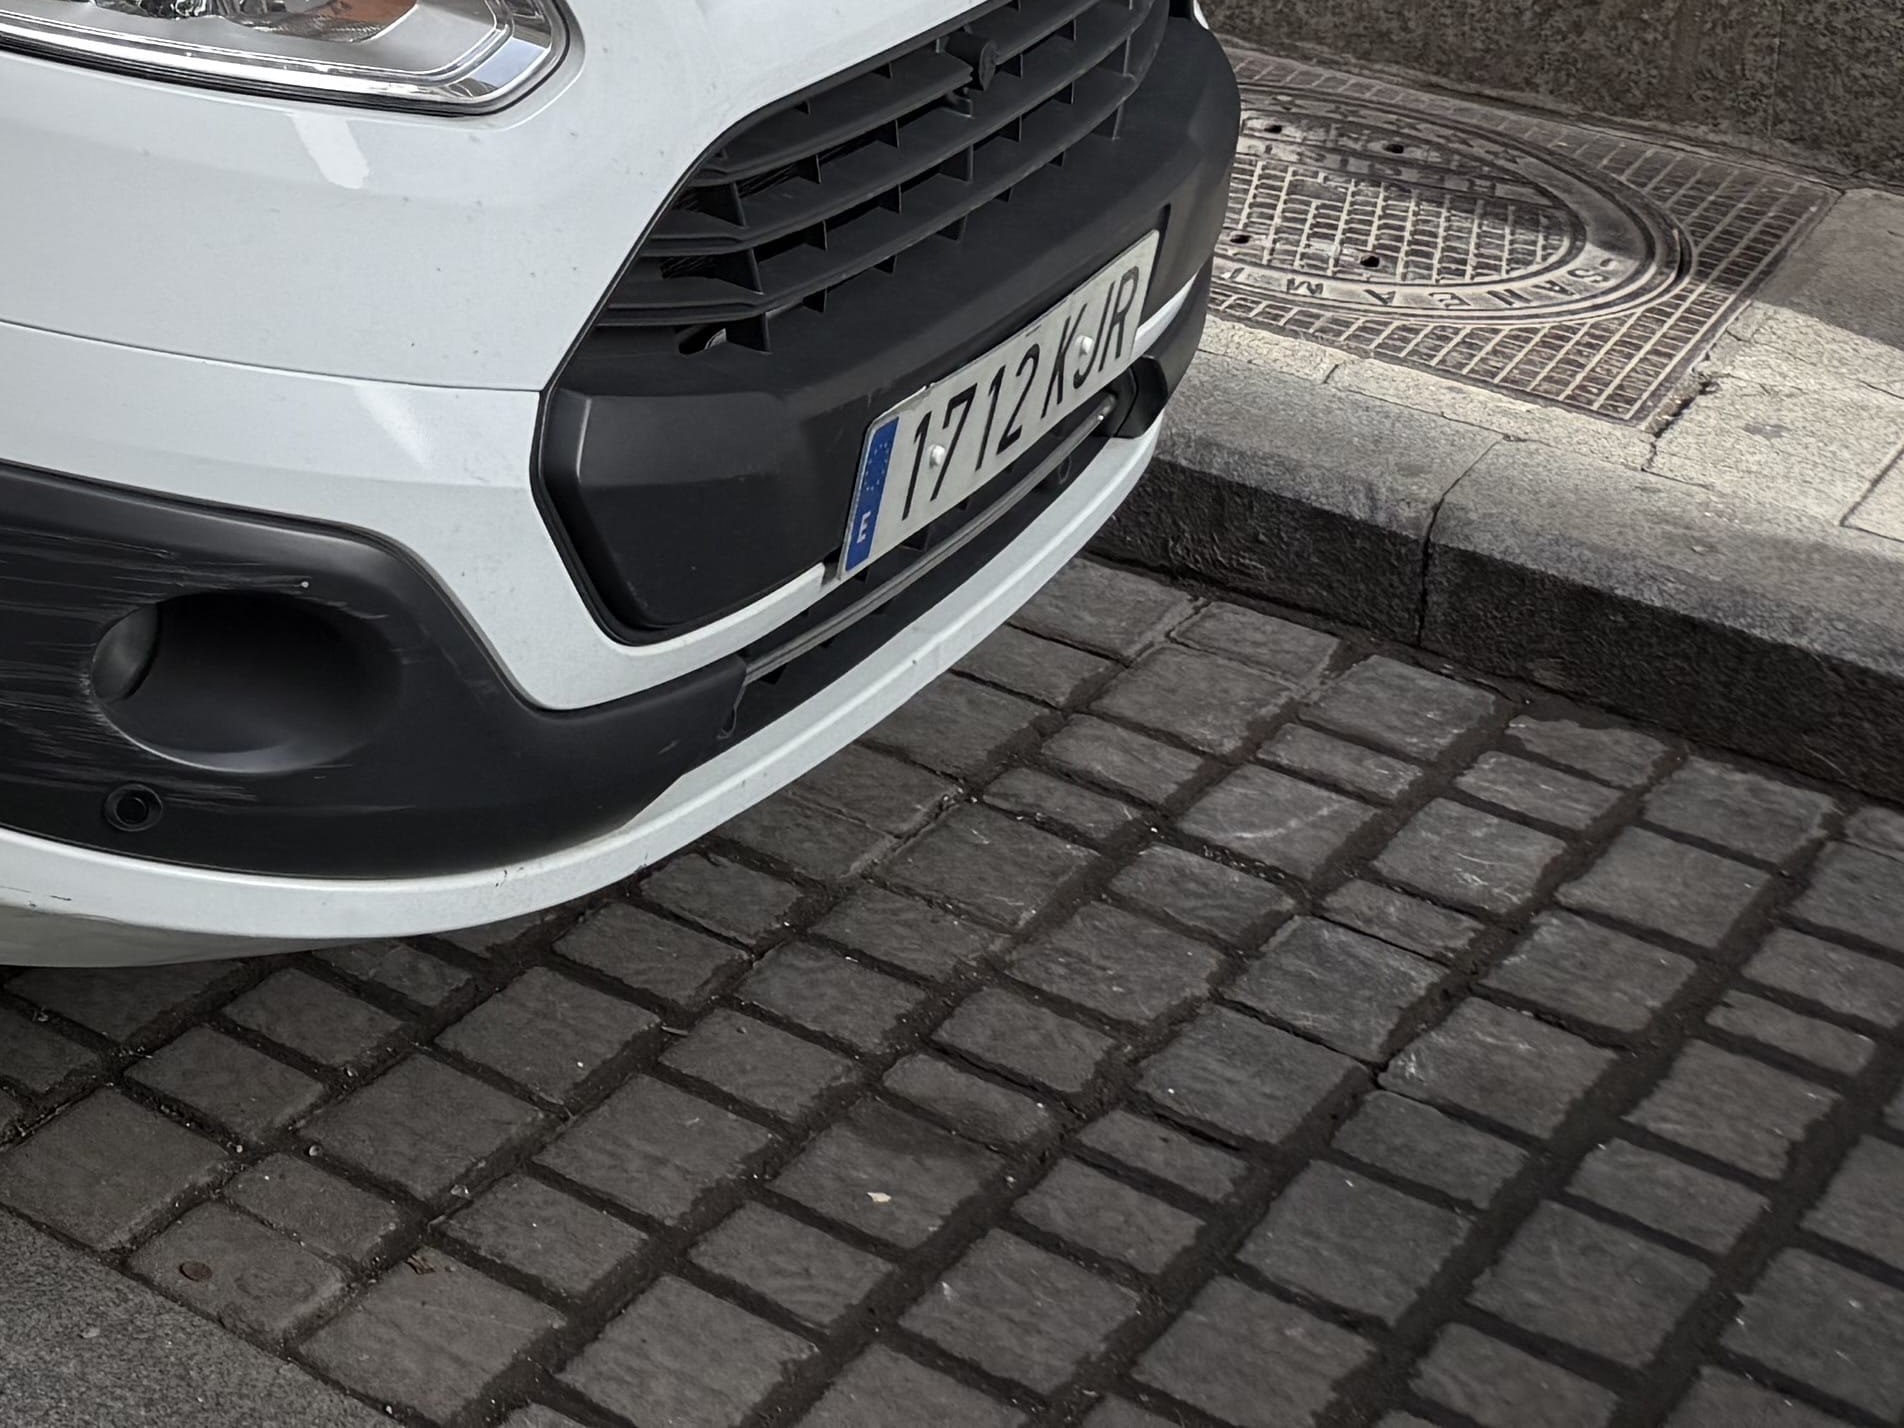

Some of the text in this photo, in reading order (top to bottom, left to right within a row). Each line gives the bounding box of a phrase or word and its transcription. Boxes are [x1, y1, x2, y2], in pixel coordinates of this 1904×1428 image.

[901, 265, 1141, 521] 1712 KJR
[855, 508, 870, 544] E
